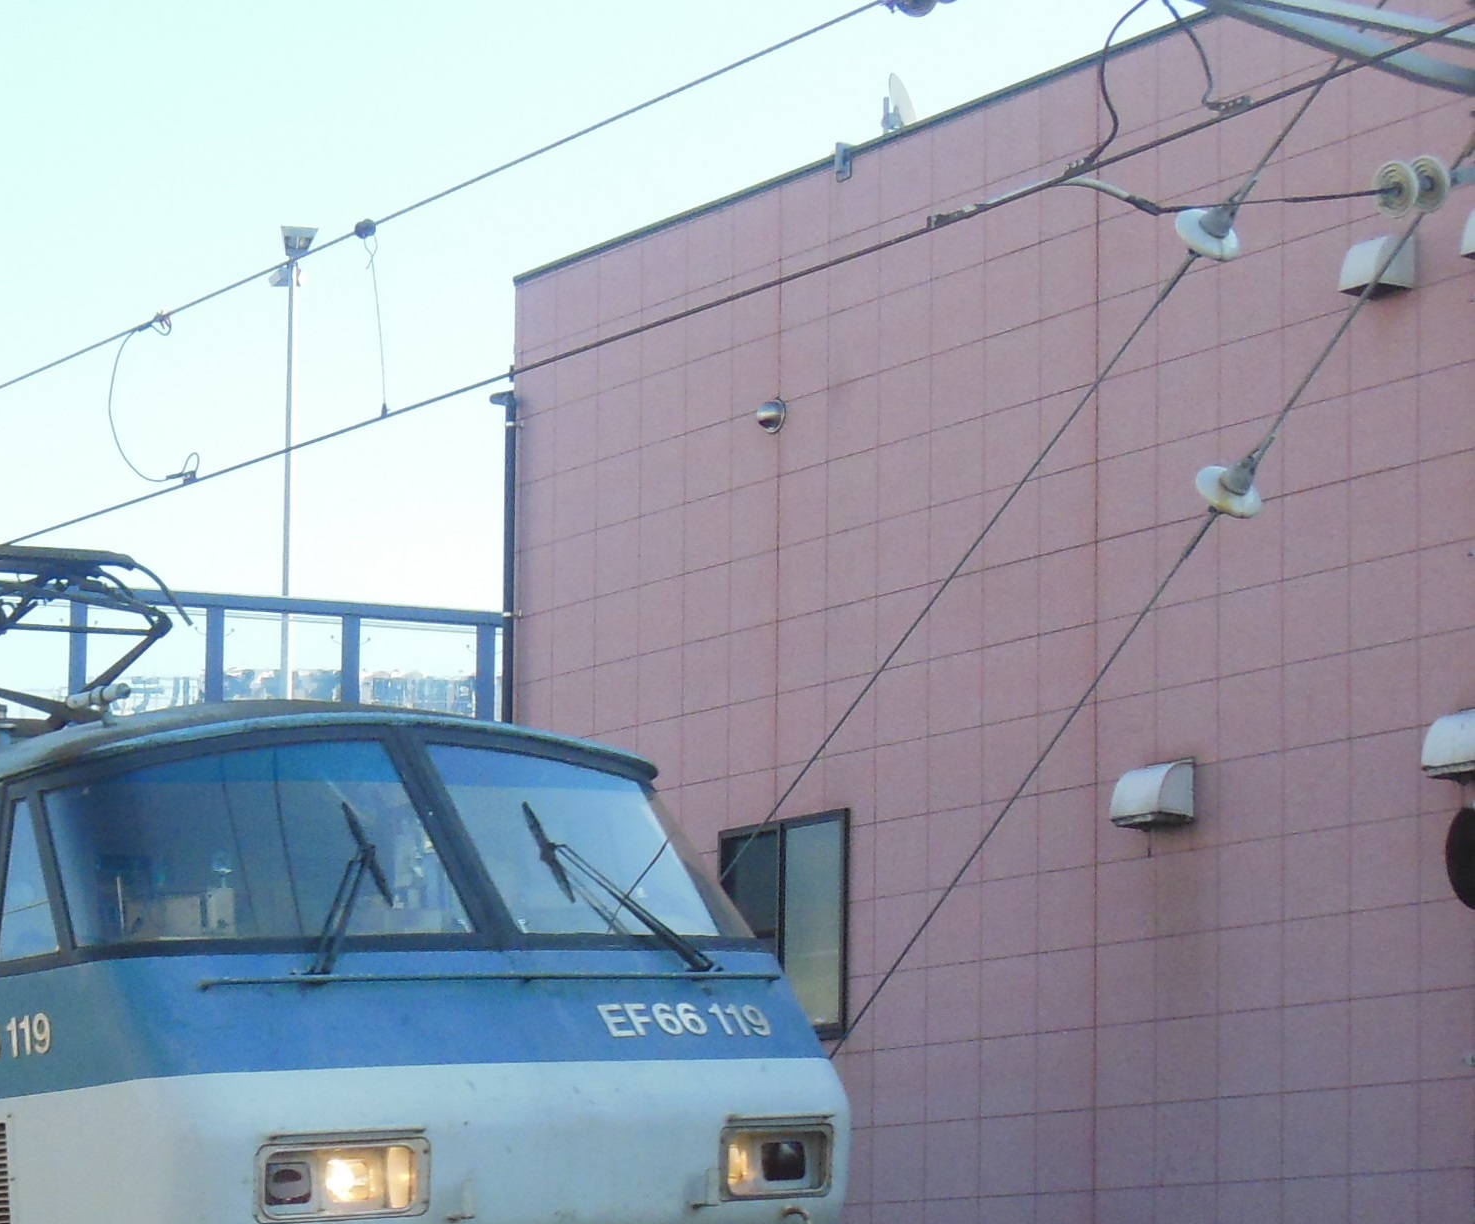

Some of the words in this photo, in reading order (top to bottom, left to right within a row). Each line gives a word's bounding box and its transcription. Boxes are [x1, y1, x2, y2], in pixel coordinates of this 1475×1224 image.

[6, 1012, 51, 1058] 119
[597, 1002, 708, 1037] EF66
[708, 1003, 771, 1036] 119
